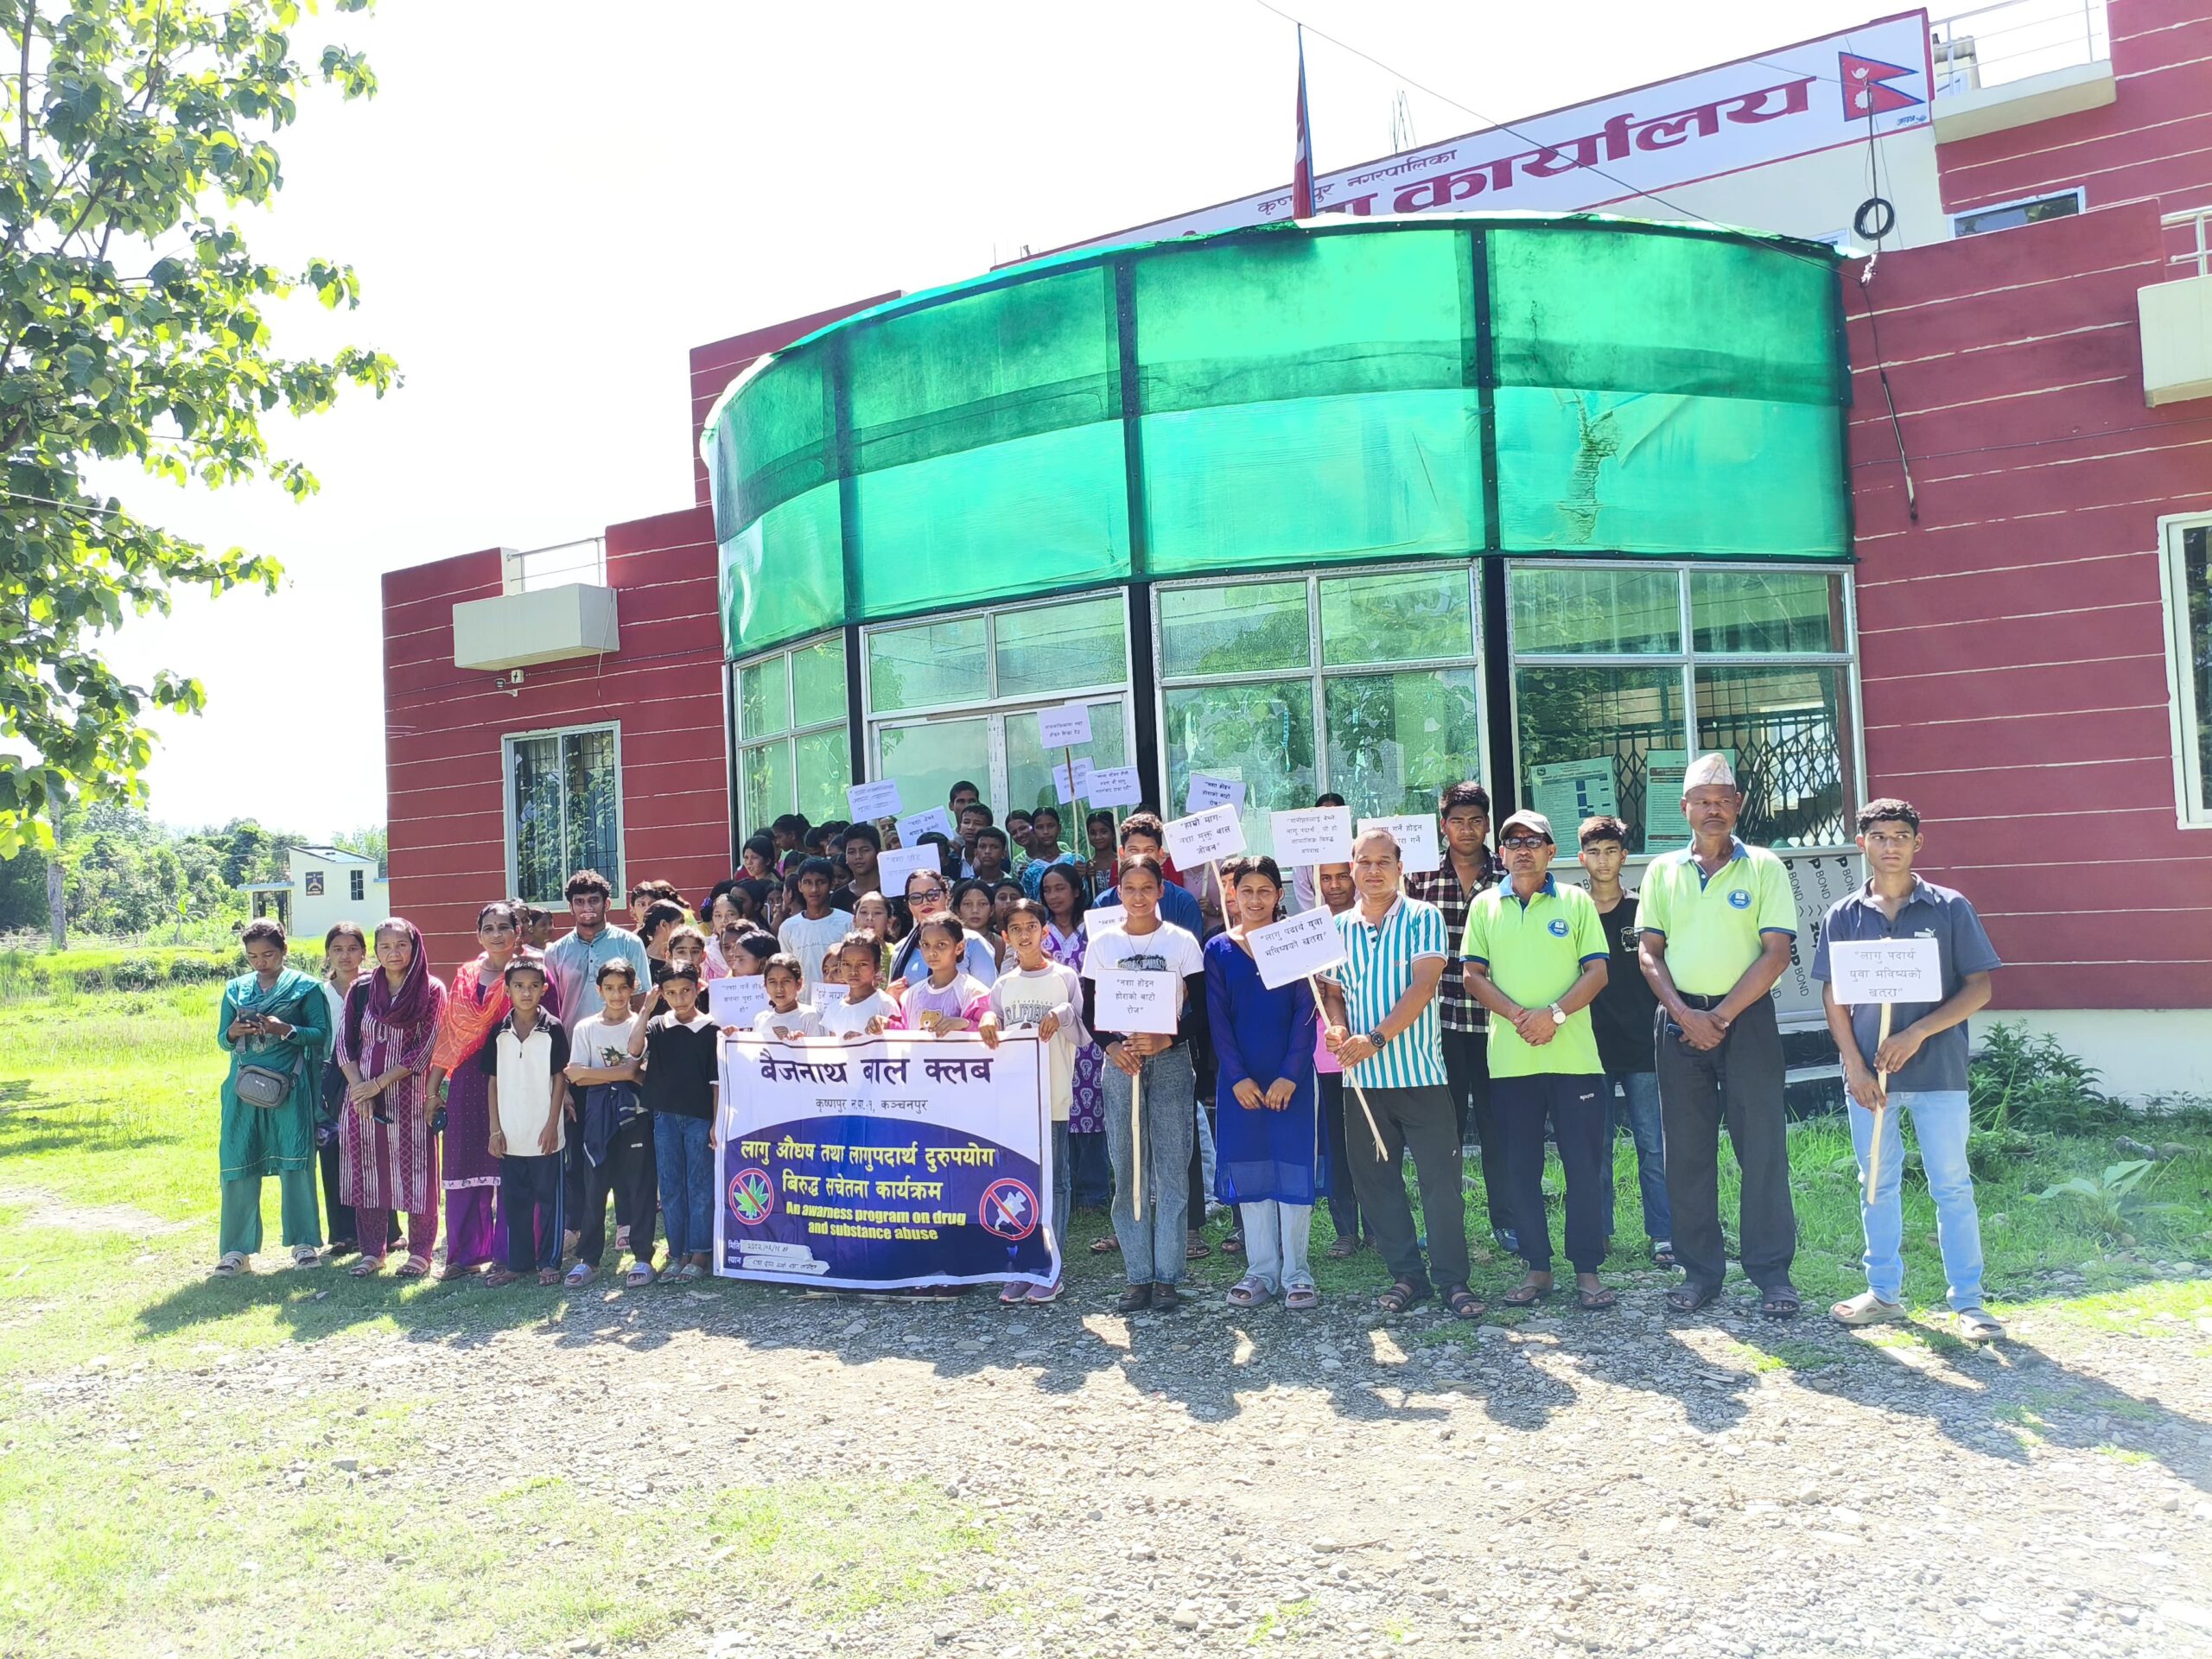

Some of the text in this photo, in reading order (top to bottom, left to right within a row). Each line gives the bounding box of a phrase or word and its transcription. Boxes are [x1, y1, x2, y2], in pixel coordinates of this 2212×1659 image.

[1393, 75, 1816, 214] कार्यालय
[1347, 149, 1458, 188] नगरपालिका
[1815, 870, 1831, 899] BOND
[1842, 868, 1857, 894] BON
[1887, 948, 1916, 960] पदार्थ
[1137, 978, 1154, 988] होइन
[1875, 967, 1923, 979] भविष्यको
[760, 1047, 995, 1085] बैजनाथ बाल क्लब
[816, 1098, 848, 1114] कृष्णपुर
[880, 1099, 929, 1115] कञ्चनपुर
[741, 1140, 772, 1166] लागु
[821, 1144, 845, 1163] तथा
[849, 1141, 918, 1173] लागुपदार्थ
[925, 1141, 996, 1173] दुरुपयोग
[782, 1168, 944, 1201] बिरुद्ध सचेतना कार्यक्रम
[786, 1201, 967, 1226] An awarness program on drug
[808, 1221, 939, 1241] and substance abuse
